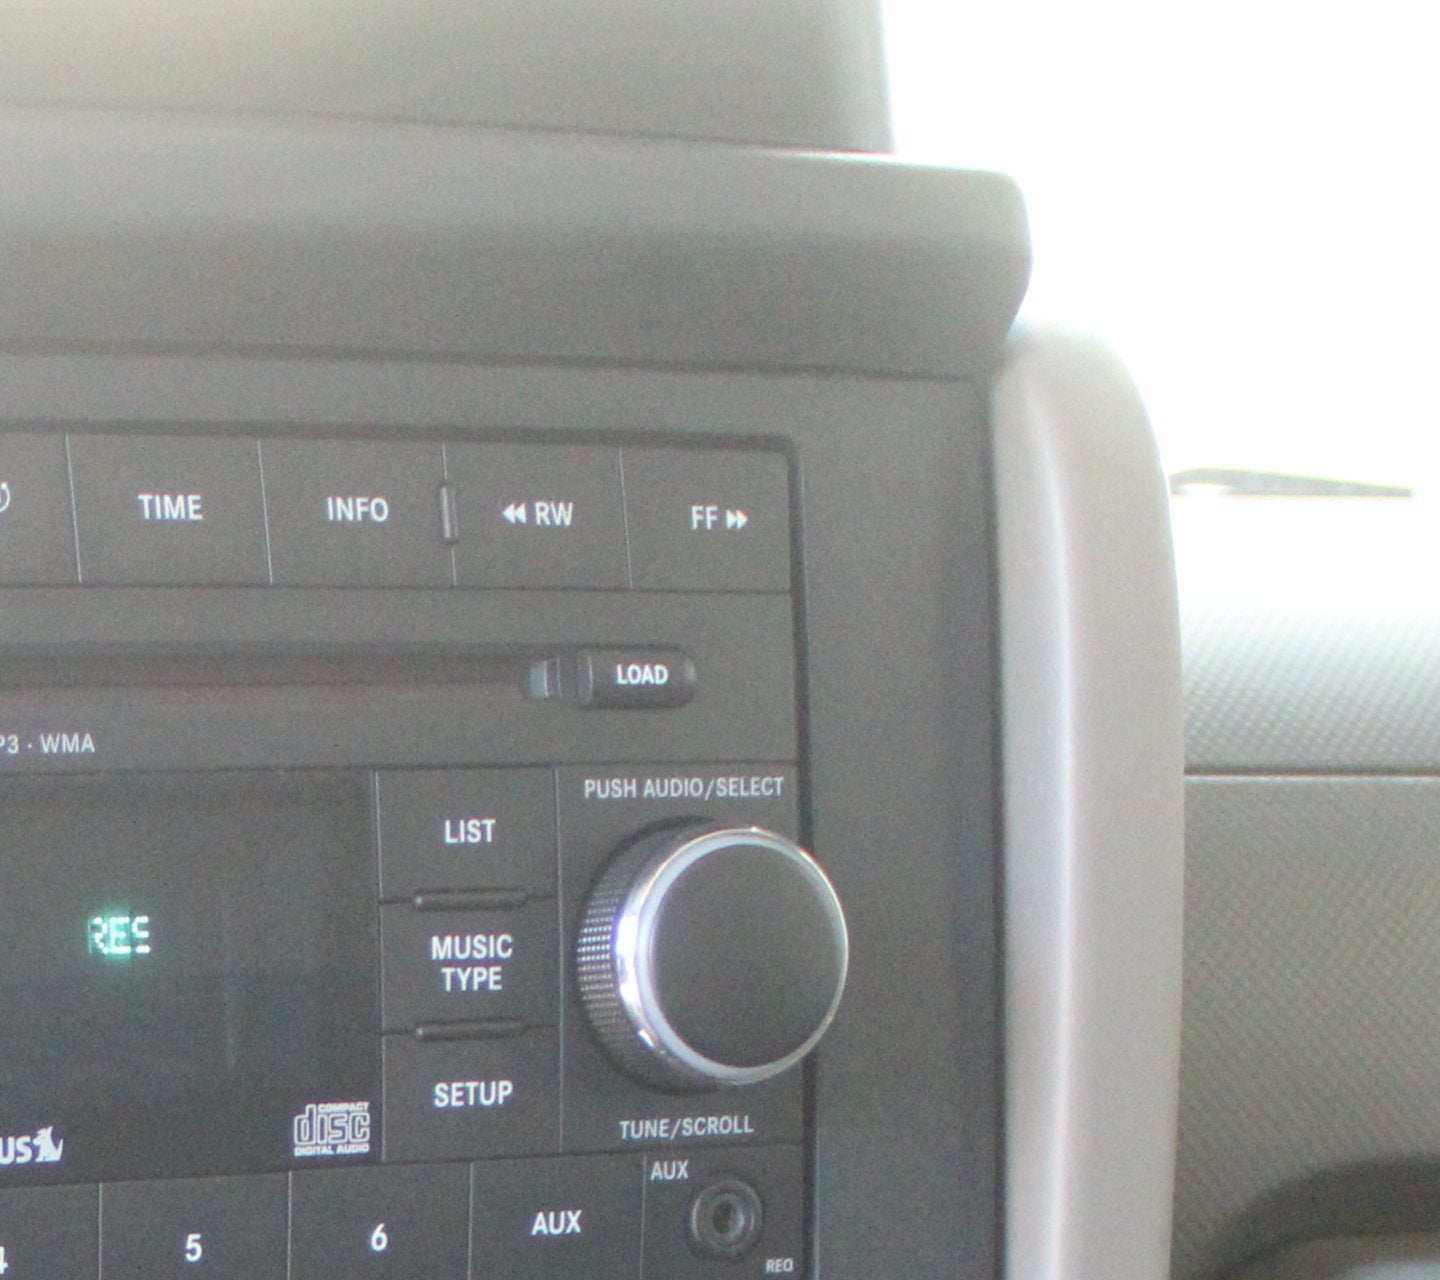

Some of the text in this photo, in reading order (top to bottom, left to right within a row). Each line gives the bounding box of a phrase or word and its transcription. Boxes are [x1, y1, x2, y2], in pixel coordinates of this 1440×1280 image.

[137, 493, 203, 521] TIME
[326, 496, 389, 523] INFO
[534, 500, 574, 527] RW
[691, 504, 718, 530] FF
[616, 663, 669, 685] LOAD
[39, 732, 96, 754] WMA
[583, 776, 785, 801] PUSH AUDIO/SELECT
[444, 818, 496, 844] LIST
[430, 933, 513, 960] MUSIC
[440, 965, 502, 992] TYPE
[433, 1079, 514, 1108] SETUP
[619, 1114, 754, 1140] TUNE/SCROLL
[336, 1143, 370, 1155] AUDIO
[649, 1159, 689, 1181] AUX
[531, 1209, 582, 1236] AUX
[185, 1233, 203, 1263] 5
[370, 1223, 388, 1252] 6
